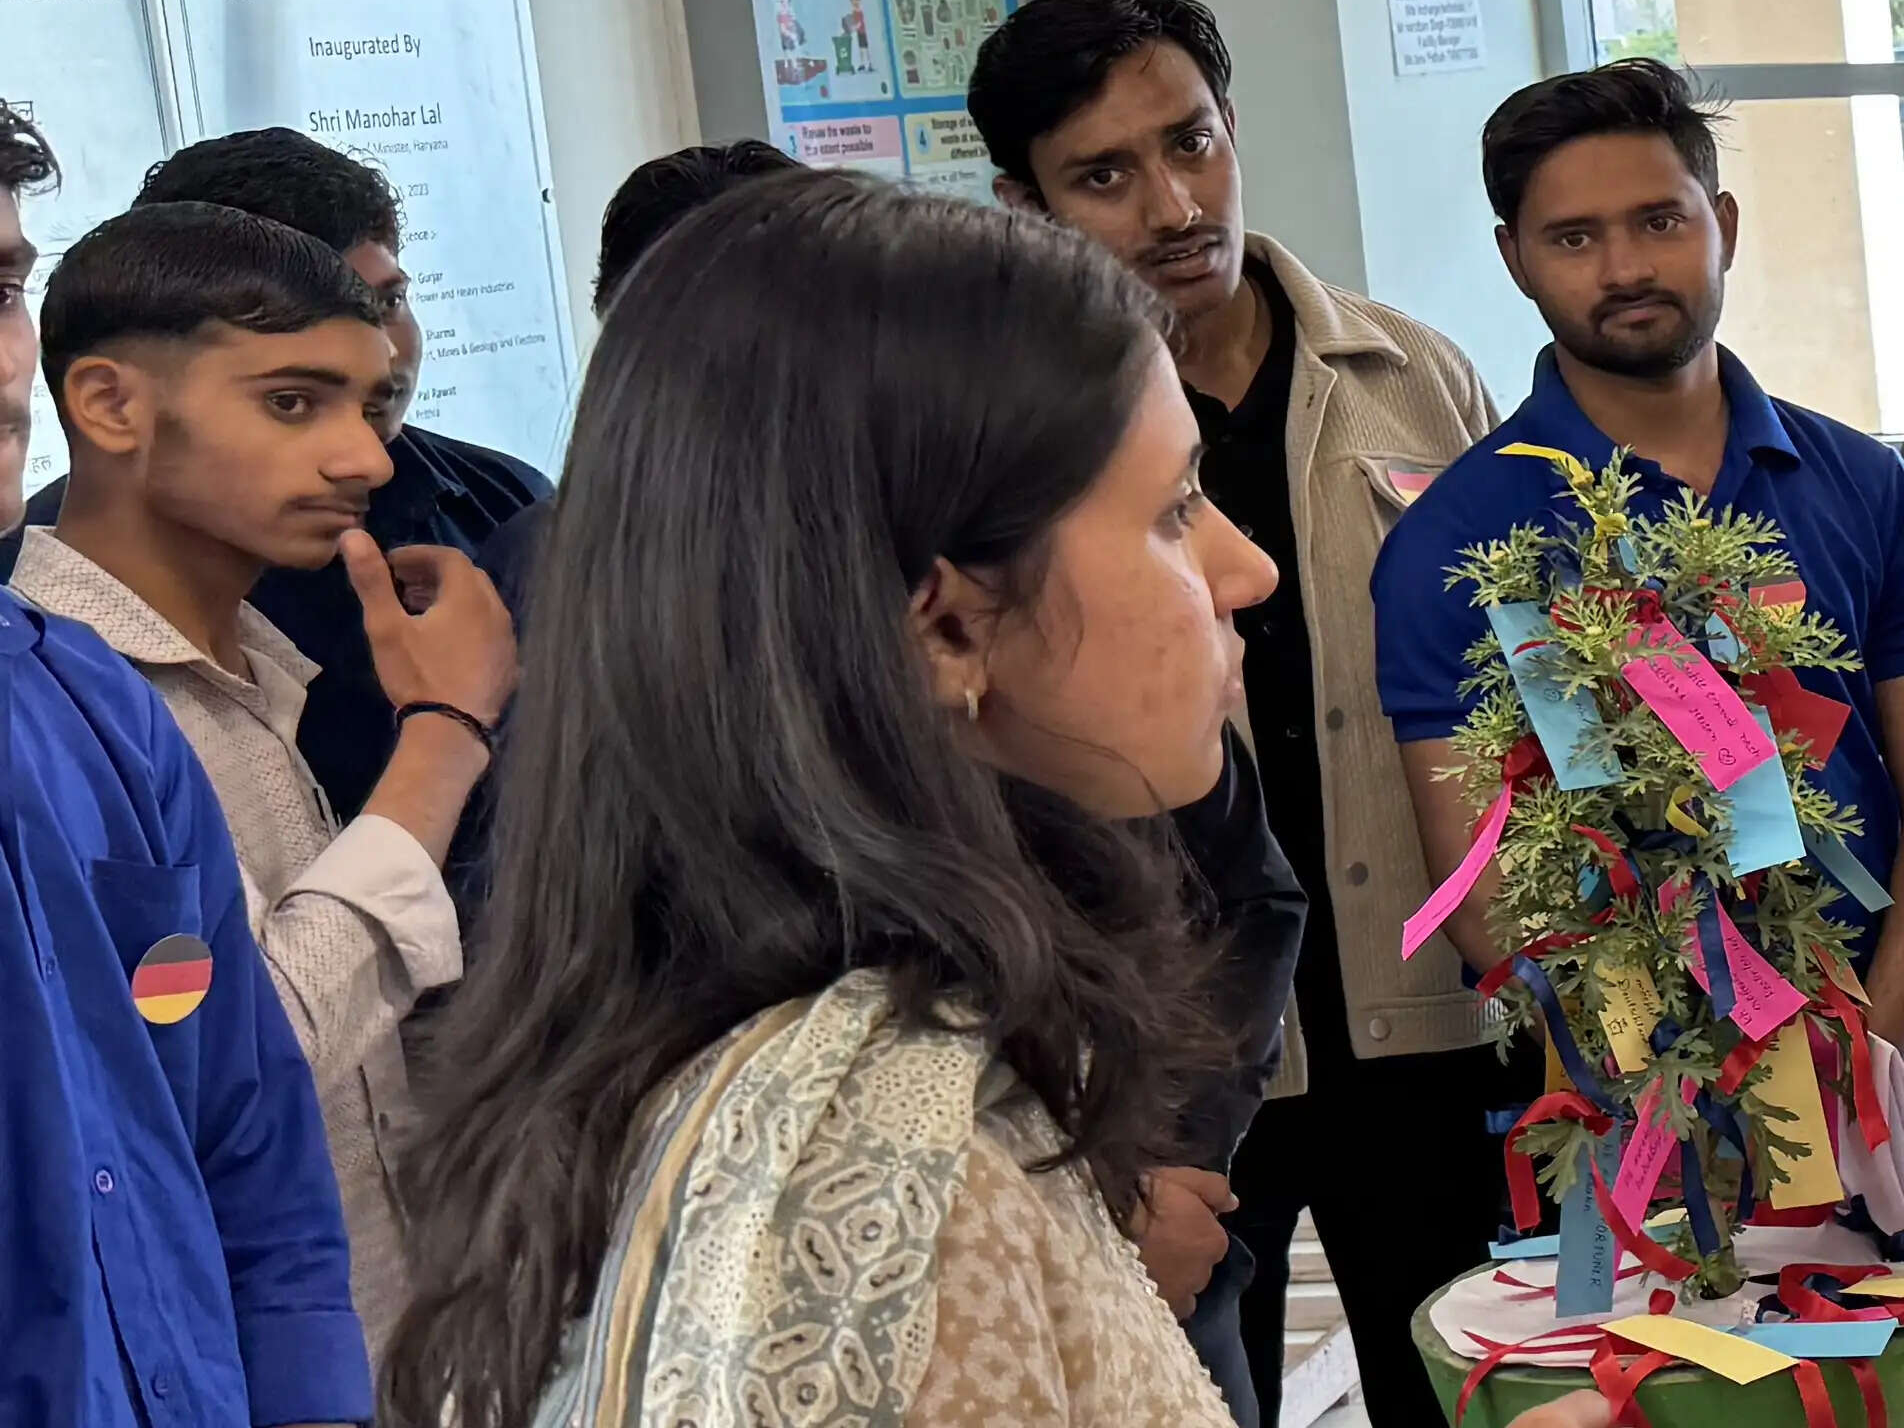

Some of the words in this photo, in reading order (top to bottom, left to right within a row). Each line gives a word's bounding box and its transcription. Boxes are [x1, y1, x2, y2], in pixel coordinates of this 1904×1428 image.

[309, 34, 400, 60] Inaugurated
[403, 34, 421, 58] By
[309, 110, 341, 132] Shri
[345, 105, 416, 130] Manohar
[420, 103, 442, 125] Lal
[919, 130, 928, 147] 4
[440, 290, 455, 300] and
